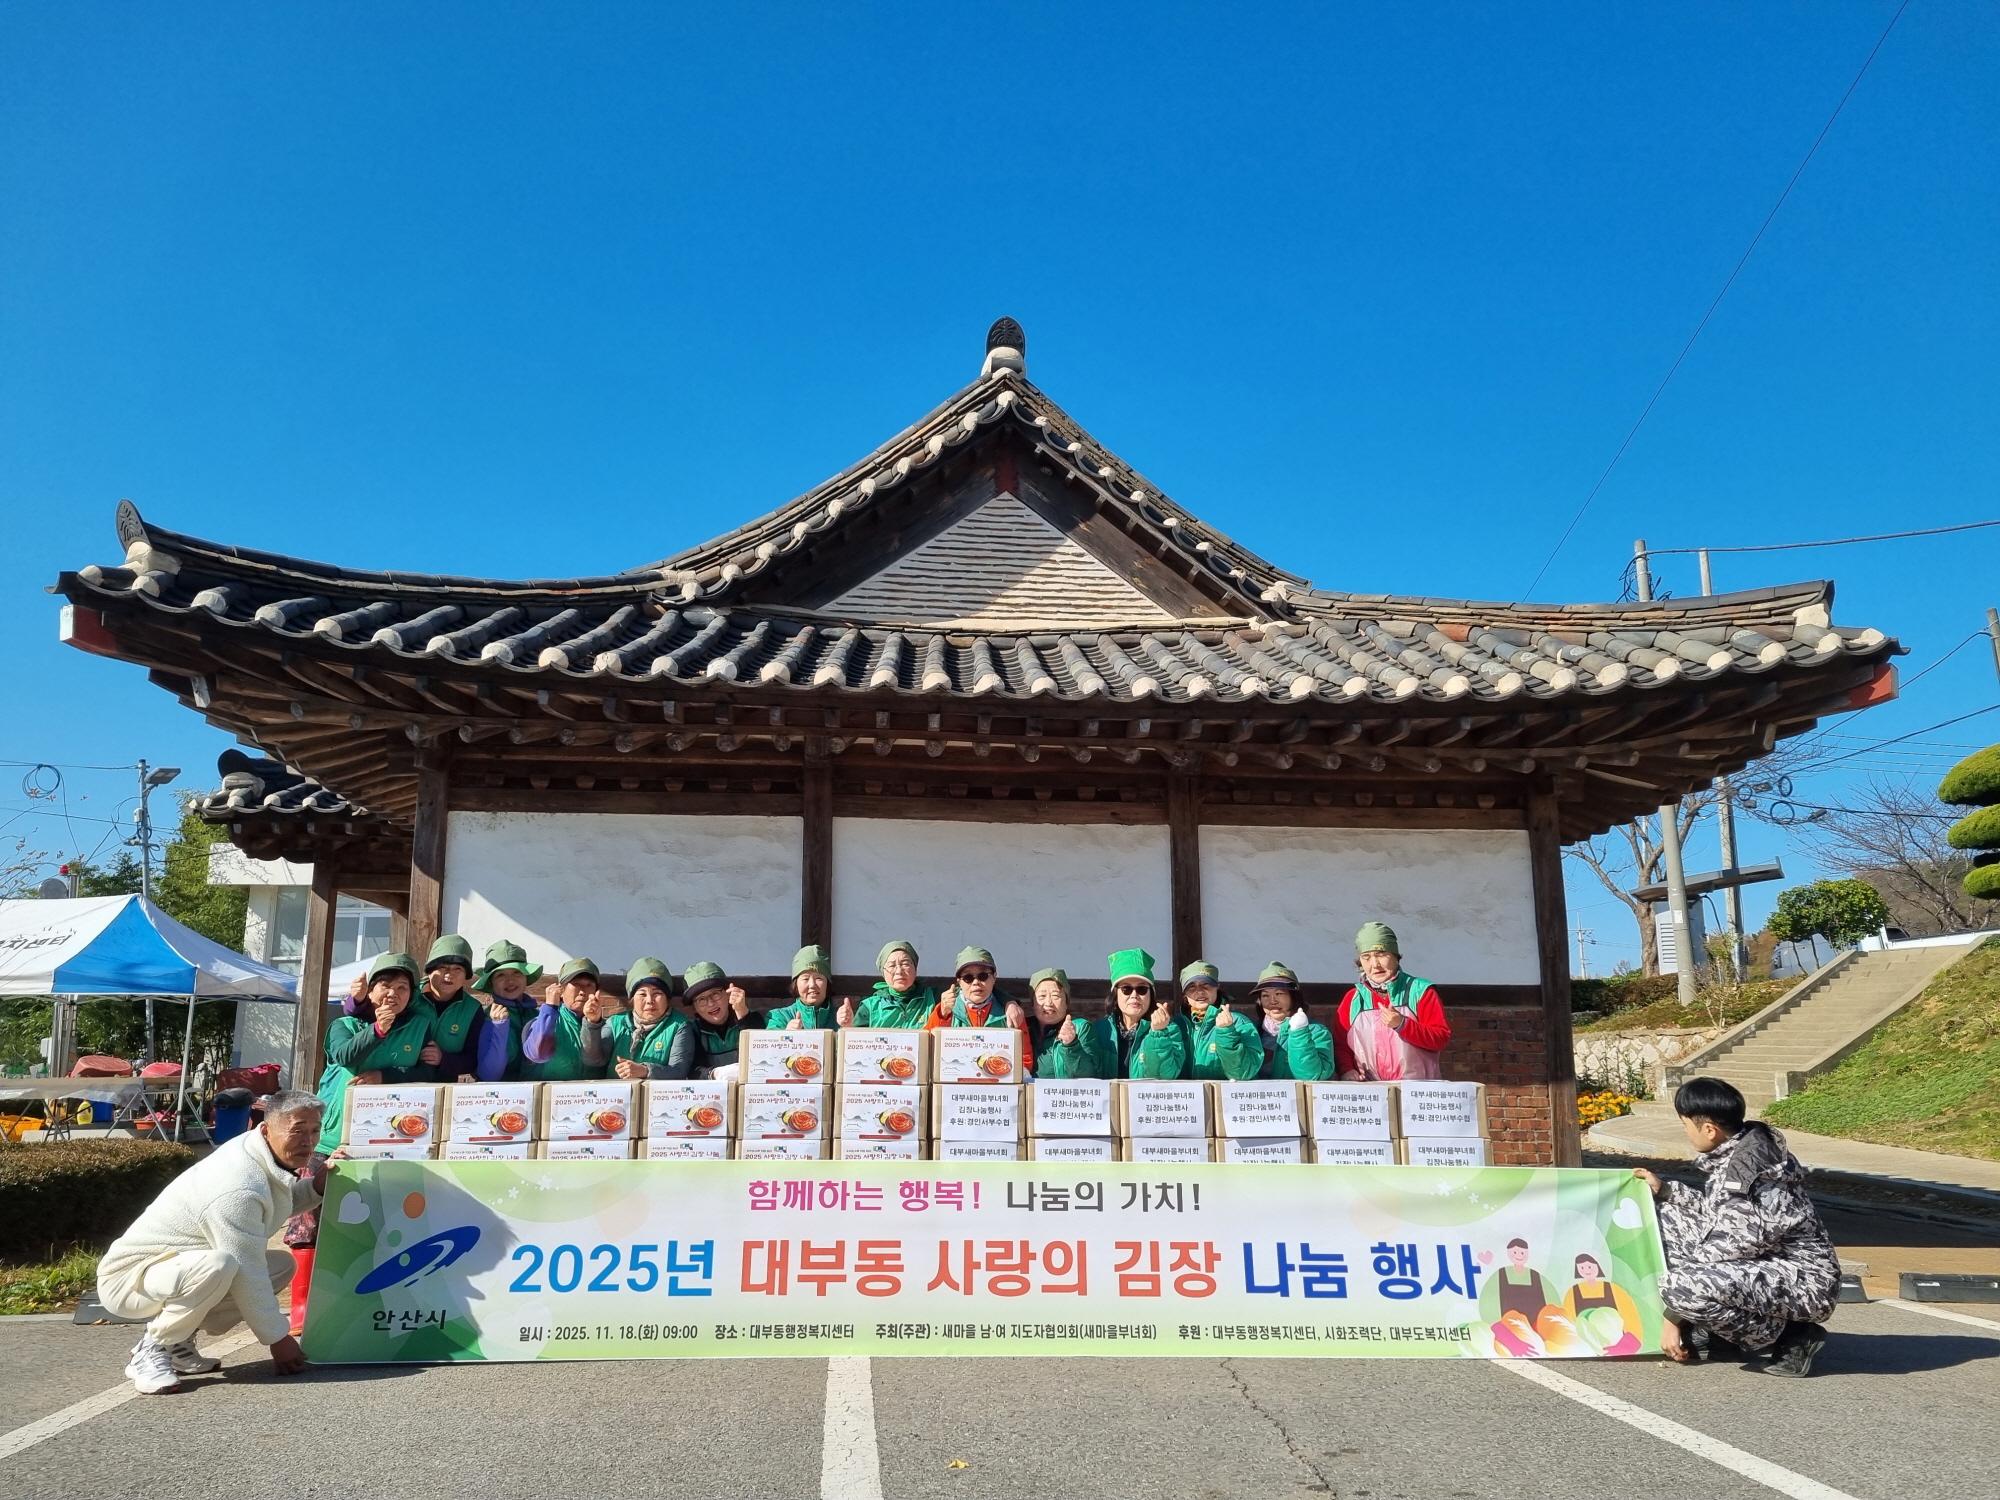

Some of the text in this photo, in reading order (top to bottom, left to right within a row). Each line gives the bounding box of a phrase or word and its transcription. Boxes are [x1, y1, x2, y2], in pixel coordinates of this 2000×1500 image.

[1044, 1088, 1100, 1096] 대부새마을부녀회
[1138, 1092, 1195, 1100] 대부새마을부녀회
[1231, 1091, 1287, 1099] 대부새마을부녀회
[952, 1094, 1009, 1102] 대부새마을부녀회
[1322, 1094, 1379, 1102] 대부새마을부녀회
[1051, 1100, 1093, 1108] 김장나눔행사
[1146, 1104, 1188, 1112] 김장나눔행사
[1239, 1103, 1281, 1111] 김장나눔행사
[1042, 1112, 1102, 1120] 후원:경인서부수협
[1411, 1114, 1470, 1122] 후원:경인서부수협
[950, 1118, 1010, 1126] 후원:경인서부수협
[749, 1181, 1199, 1212] 함께하는 행복! 나눔의 가치!
[509, 1240, 1481, 1299] 2025년 대부동 사랑의 김장 나눔 행사
[372, 1309, 447, 1331] 안산시
[520, 1327, 543, 1341] 일시
[555, 1327, 589, 1340] 2025.
[596, 1326, 613, 1339] 11.
[620, 1324, 658, 1341] 18.(화)
[663, 1325, 697, 1339] 09:00
[715, 1325, 737, 1339] 장소
[750, 1324, 853, 1339] 대부동행정복지센터
[876, 1324, 930, 1339] 주최(주관)
[942, 1324, 976, 1338] 새마을
[981, 1324, 1005, 1338] 남·여
[1011, 1324, 1156, 1340] 지도자협의회(새마을부녀회)
[1179, 1325, 1201, 1339] 후원
[1213, 1325, 1320, 1341] 대부동행정복지센터,
[1325, 1326, 1386, 1341] 시화조력단,
[1390, 1324, 1471, 1341] 대부도복지센터
